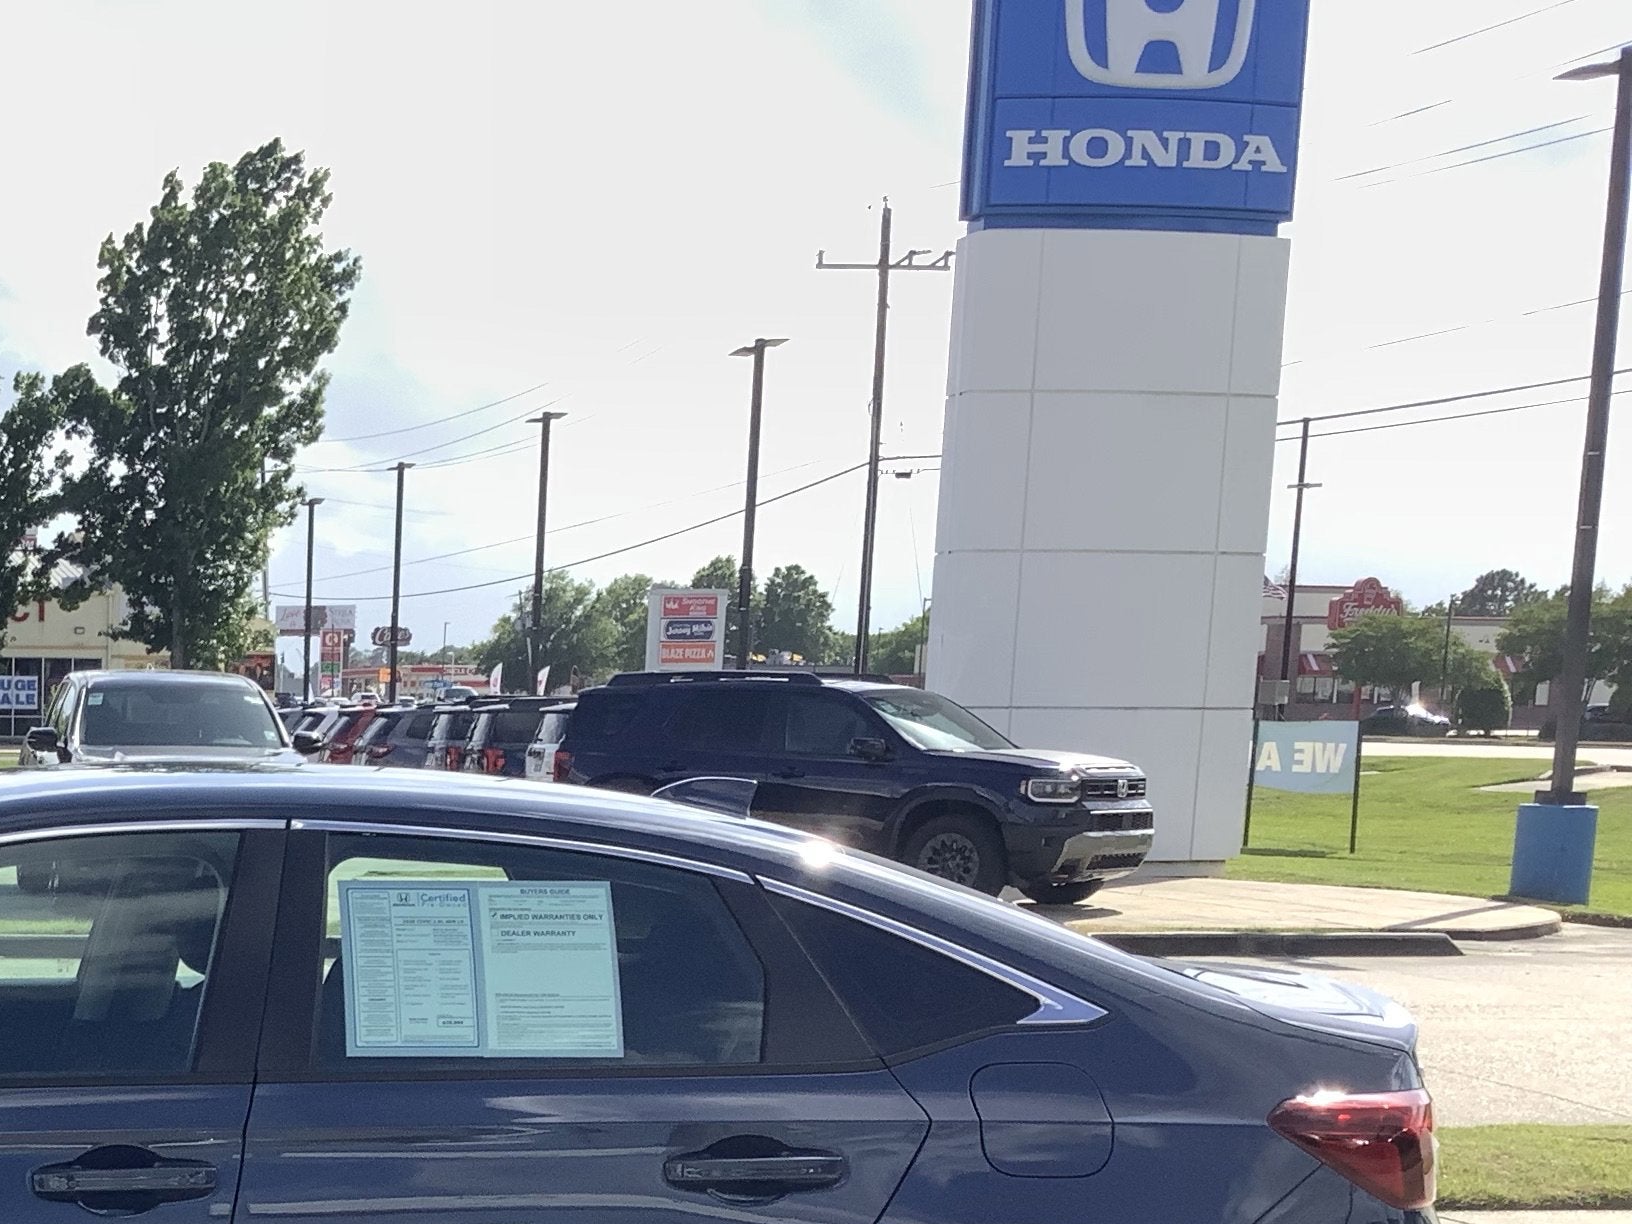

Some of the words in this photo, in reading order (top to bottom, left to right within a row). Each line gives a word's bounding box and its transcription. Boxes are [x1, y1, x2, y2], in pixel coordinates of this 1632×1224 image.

[1003, 128, 1287, 173] HONDA
[374, 627, 410, 645] Caes
[520, 888, 548, 896] BUYERS
[549, 888, 570, 896] GUIDE
[420, 892, 466, 903] Certified
[499, 913, 530, 921] IMPLIED
[531, 913, 582, 921] WARRANTIES
[582, 913, 604, 921] ONLY
[500, 929, 531, 937] DEALER
